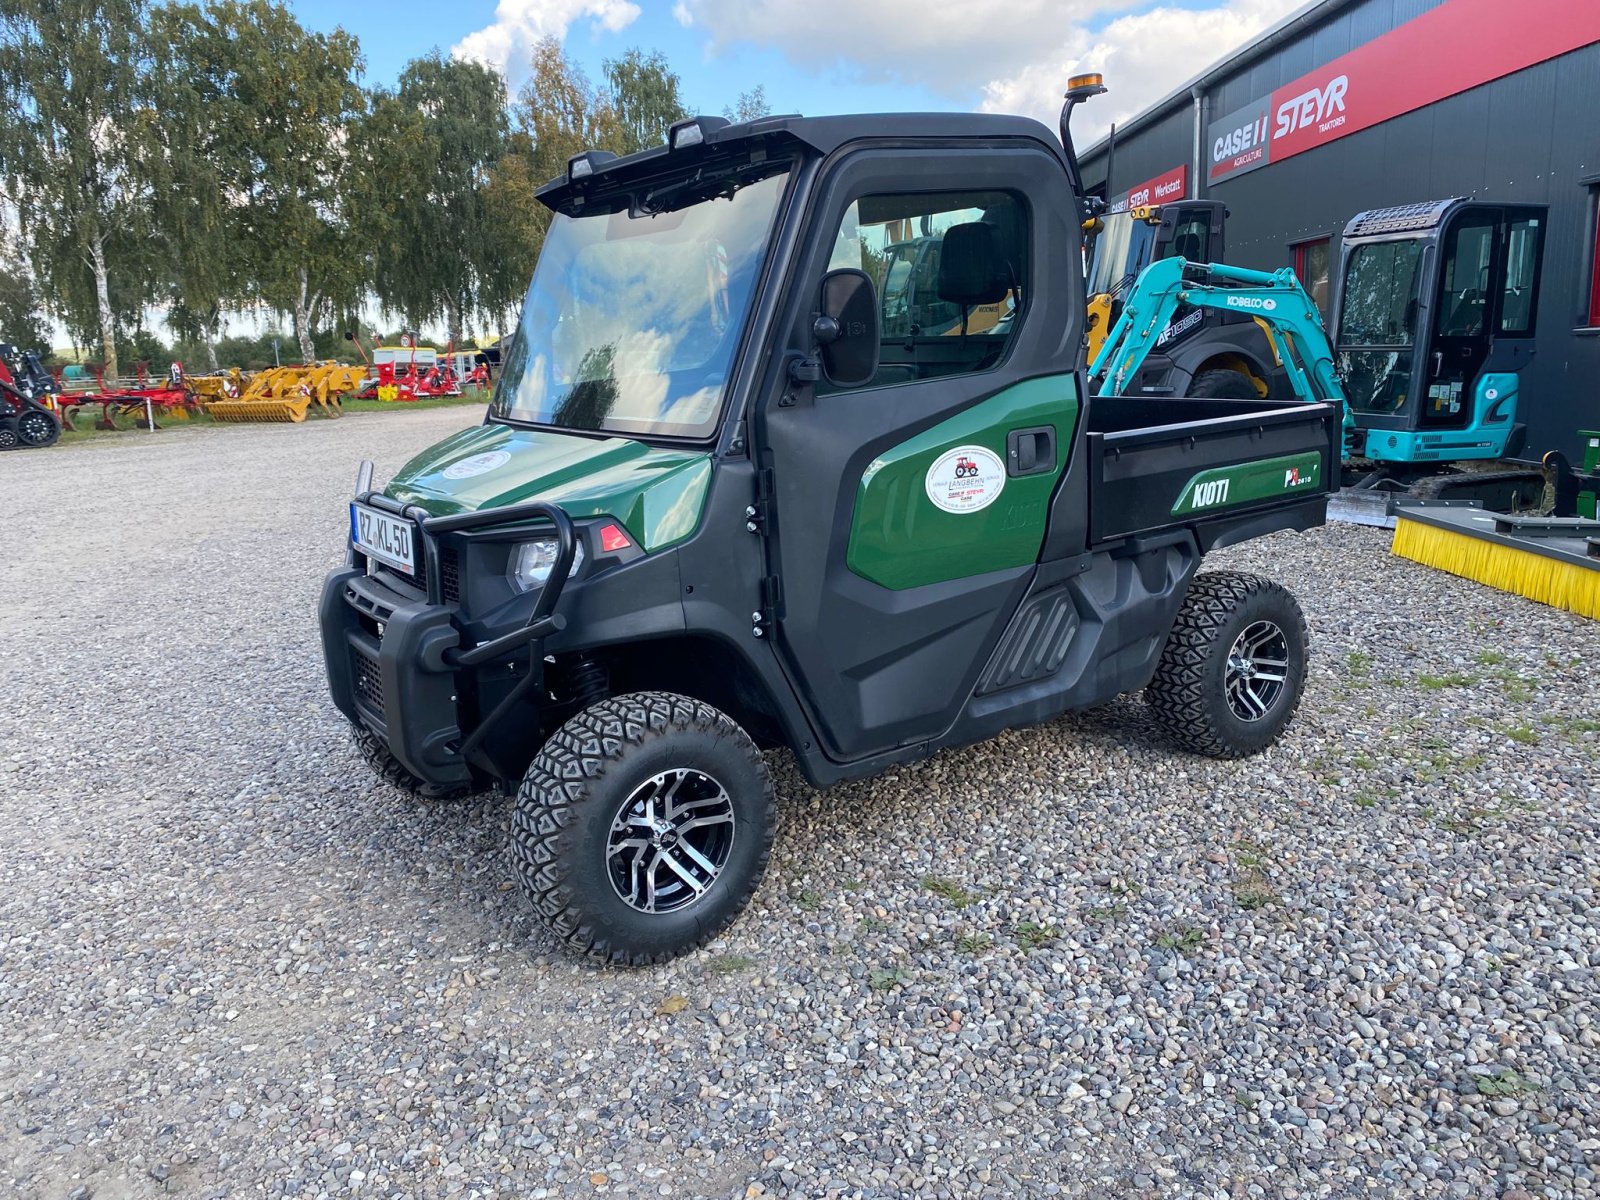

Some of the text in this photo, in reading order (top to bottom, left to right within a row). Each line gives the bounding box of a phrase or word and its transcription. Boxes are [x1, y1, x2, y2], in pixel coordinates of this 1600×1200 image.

[1273, 75, 1348, 139] STEYR
[1319, 115, 1345, 133] TRAKTOREN
[1213, 123, 1253, 161] CASE
[1233, 149, 1262, 167] AGRICULTURE
[1130, 189, 1149, 209] STEYR
[1155, 178, 1180, 198] Werkstatt
[1227, 296, 1262, 309] KOBELCO
[1157, 309, 1202, 347] AF1050
[949, 478, 984, 490] LANGBEHN
[1192, 479, 1230, 508] KIOTI
[360, 511, 409, 559] RZ KL 50
